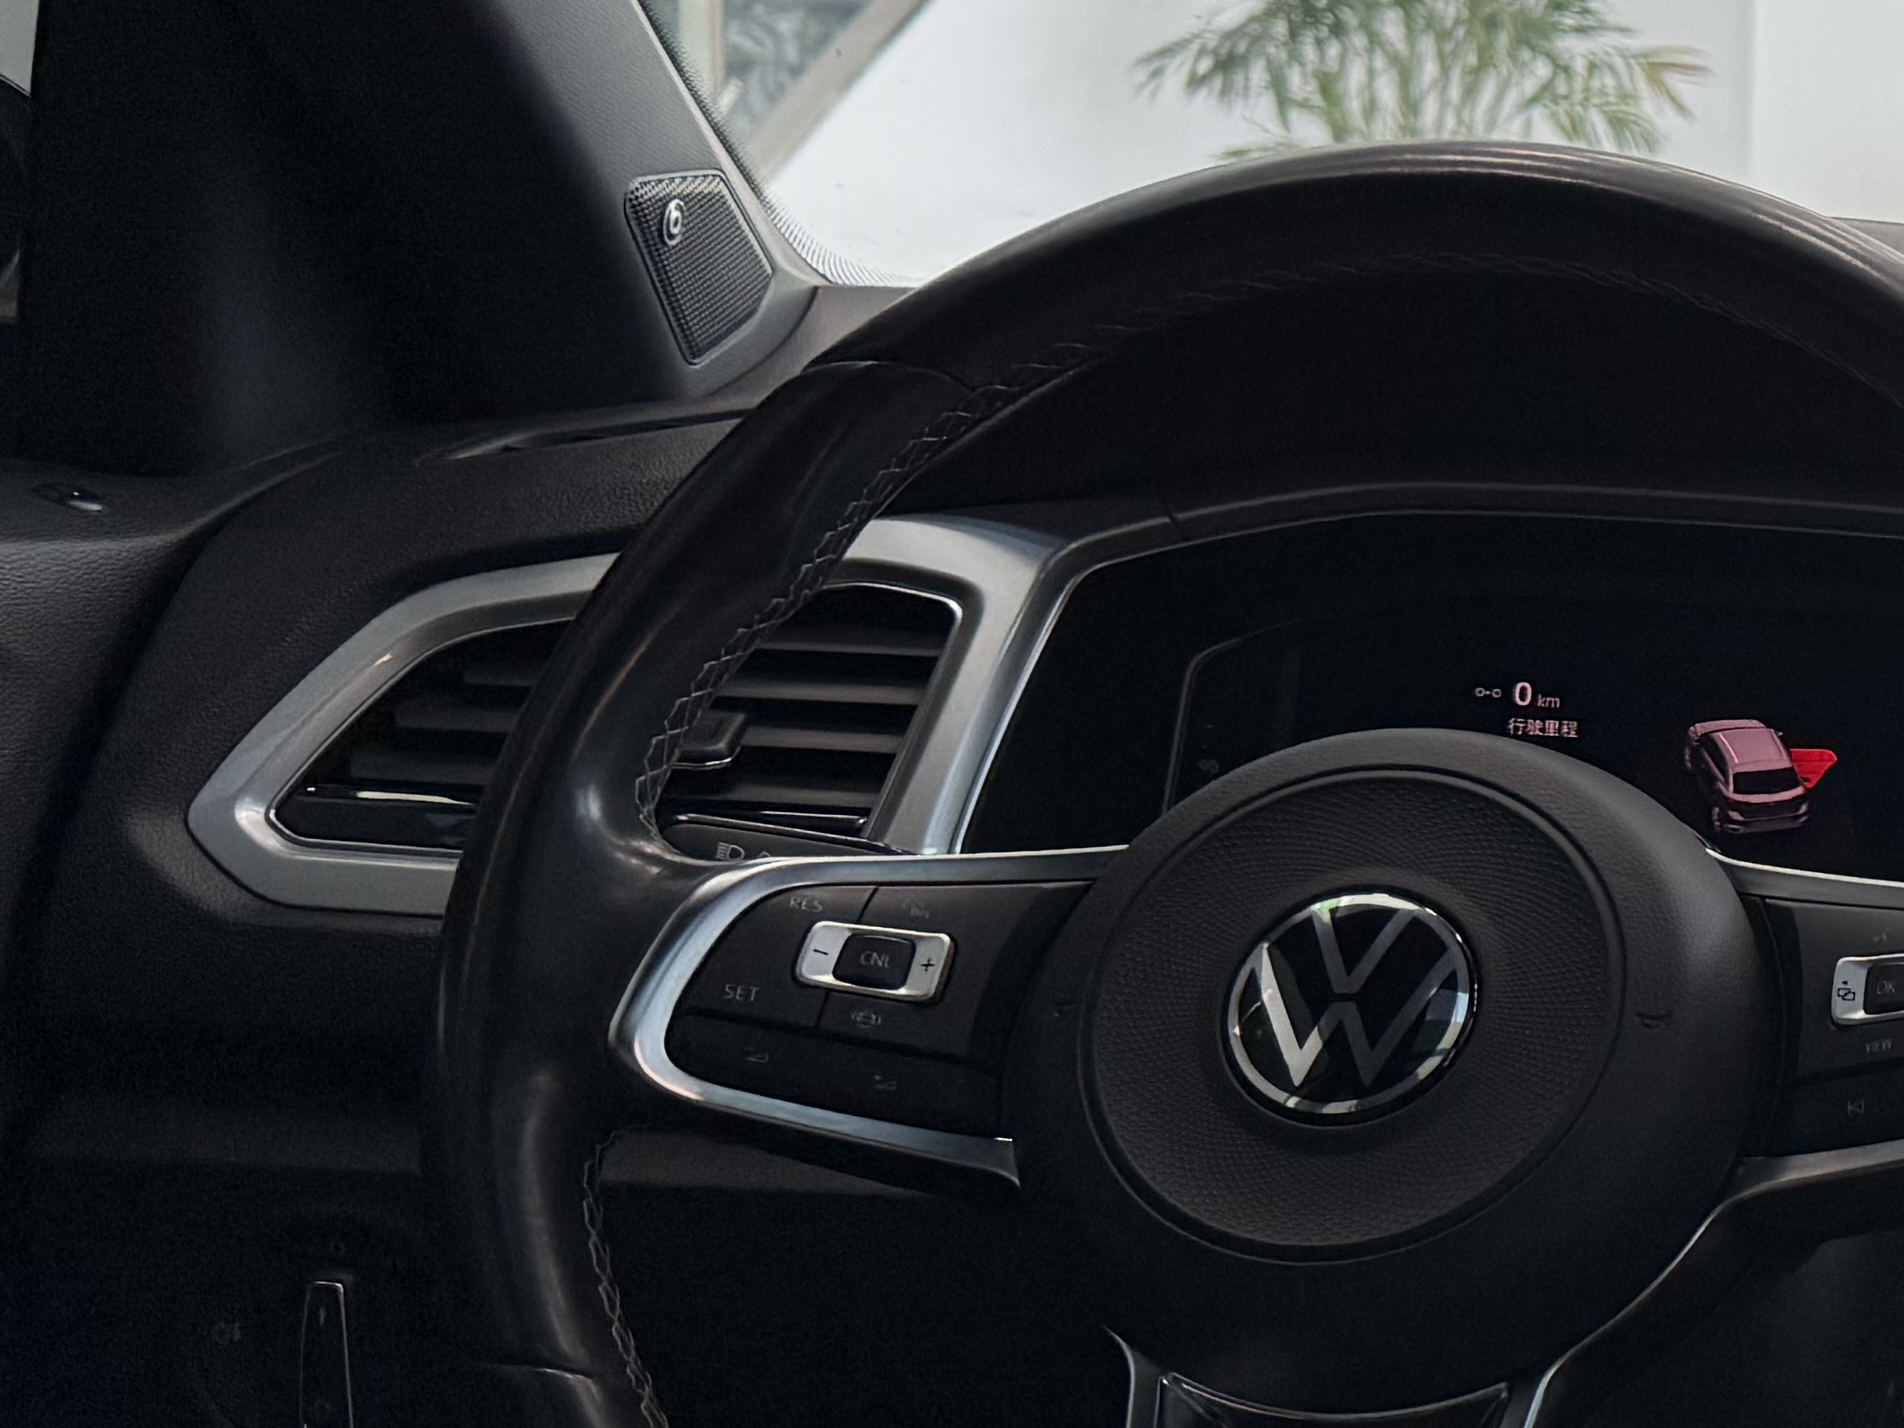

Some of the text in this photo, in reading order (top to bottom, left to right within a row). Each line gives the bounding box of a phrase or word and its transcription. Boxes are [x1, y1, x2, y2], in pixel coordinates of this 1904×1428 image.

[1514, 681, 1561, 708] 0 km
[1508, 718, 1579, 738] 行驶里程
[789, 896, 824, 913] RES
[860, 950, 892, 969] CNL
[723, 983, 760, 1002] SET
[1876, 980, 1897, 995] OK
